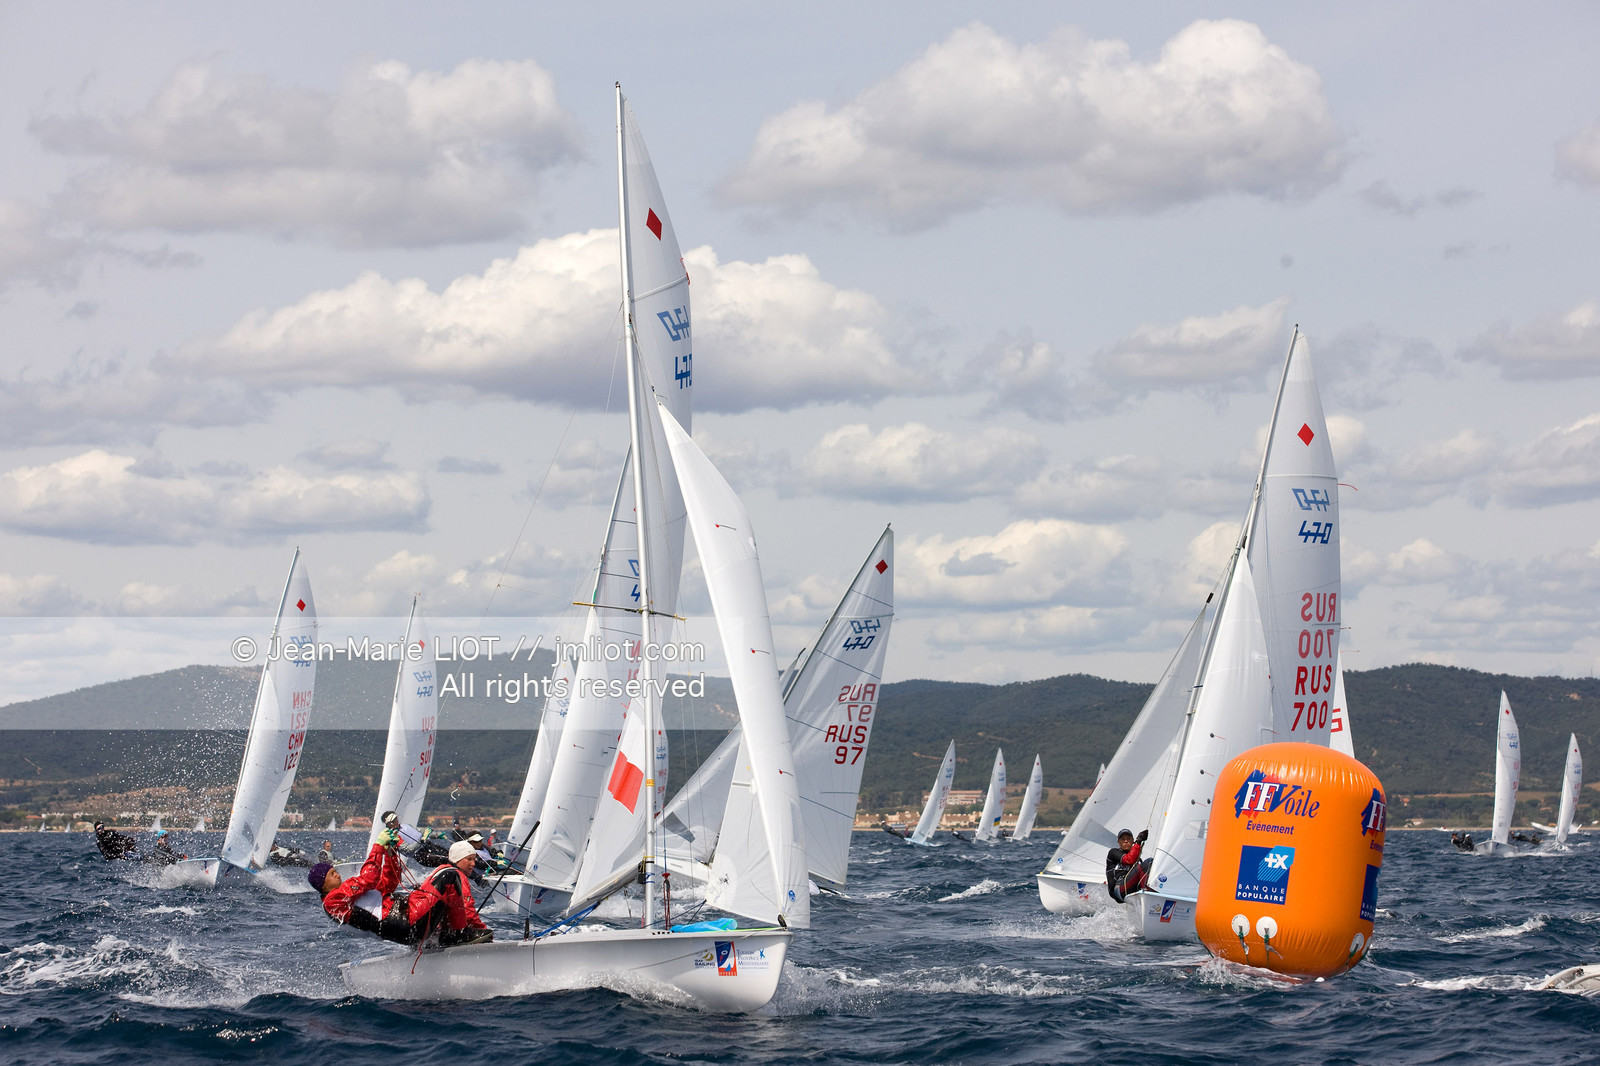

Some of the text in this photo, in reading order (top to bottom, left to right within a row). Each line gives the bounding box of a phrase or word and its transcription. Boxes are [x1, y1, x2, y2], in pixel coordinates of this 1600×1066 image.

[1298, 520, 1333, 545] 470
[843, 635, 875, 652] 470
[1294, 663, 1333, 696] RUS
[1290, 700, 1328, 732] 700
[288, 730, 305, 750] CHN
[825, 725, 867, 744] RUS
[834, 745, 864, 765] 97
[1237, 891, 1284, 903] POPULAIRE
[1238, 883, 1286, 895] BANQUE
